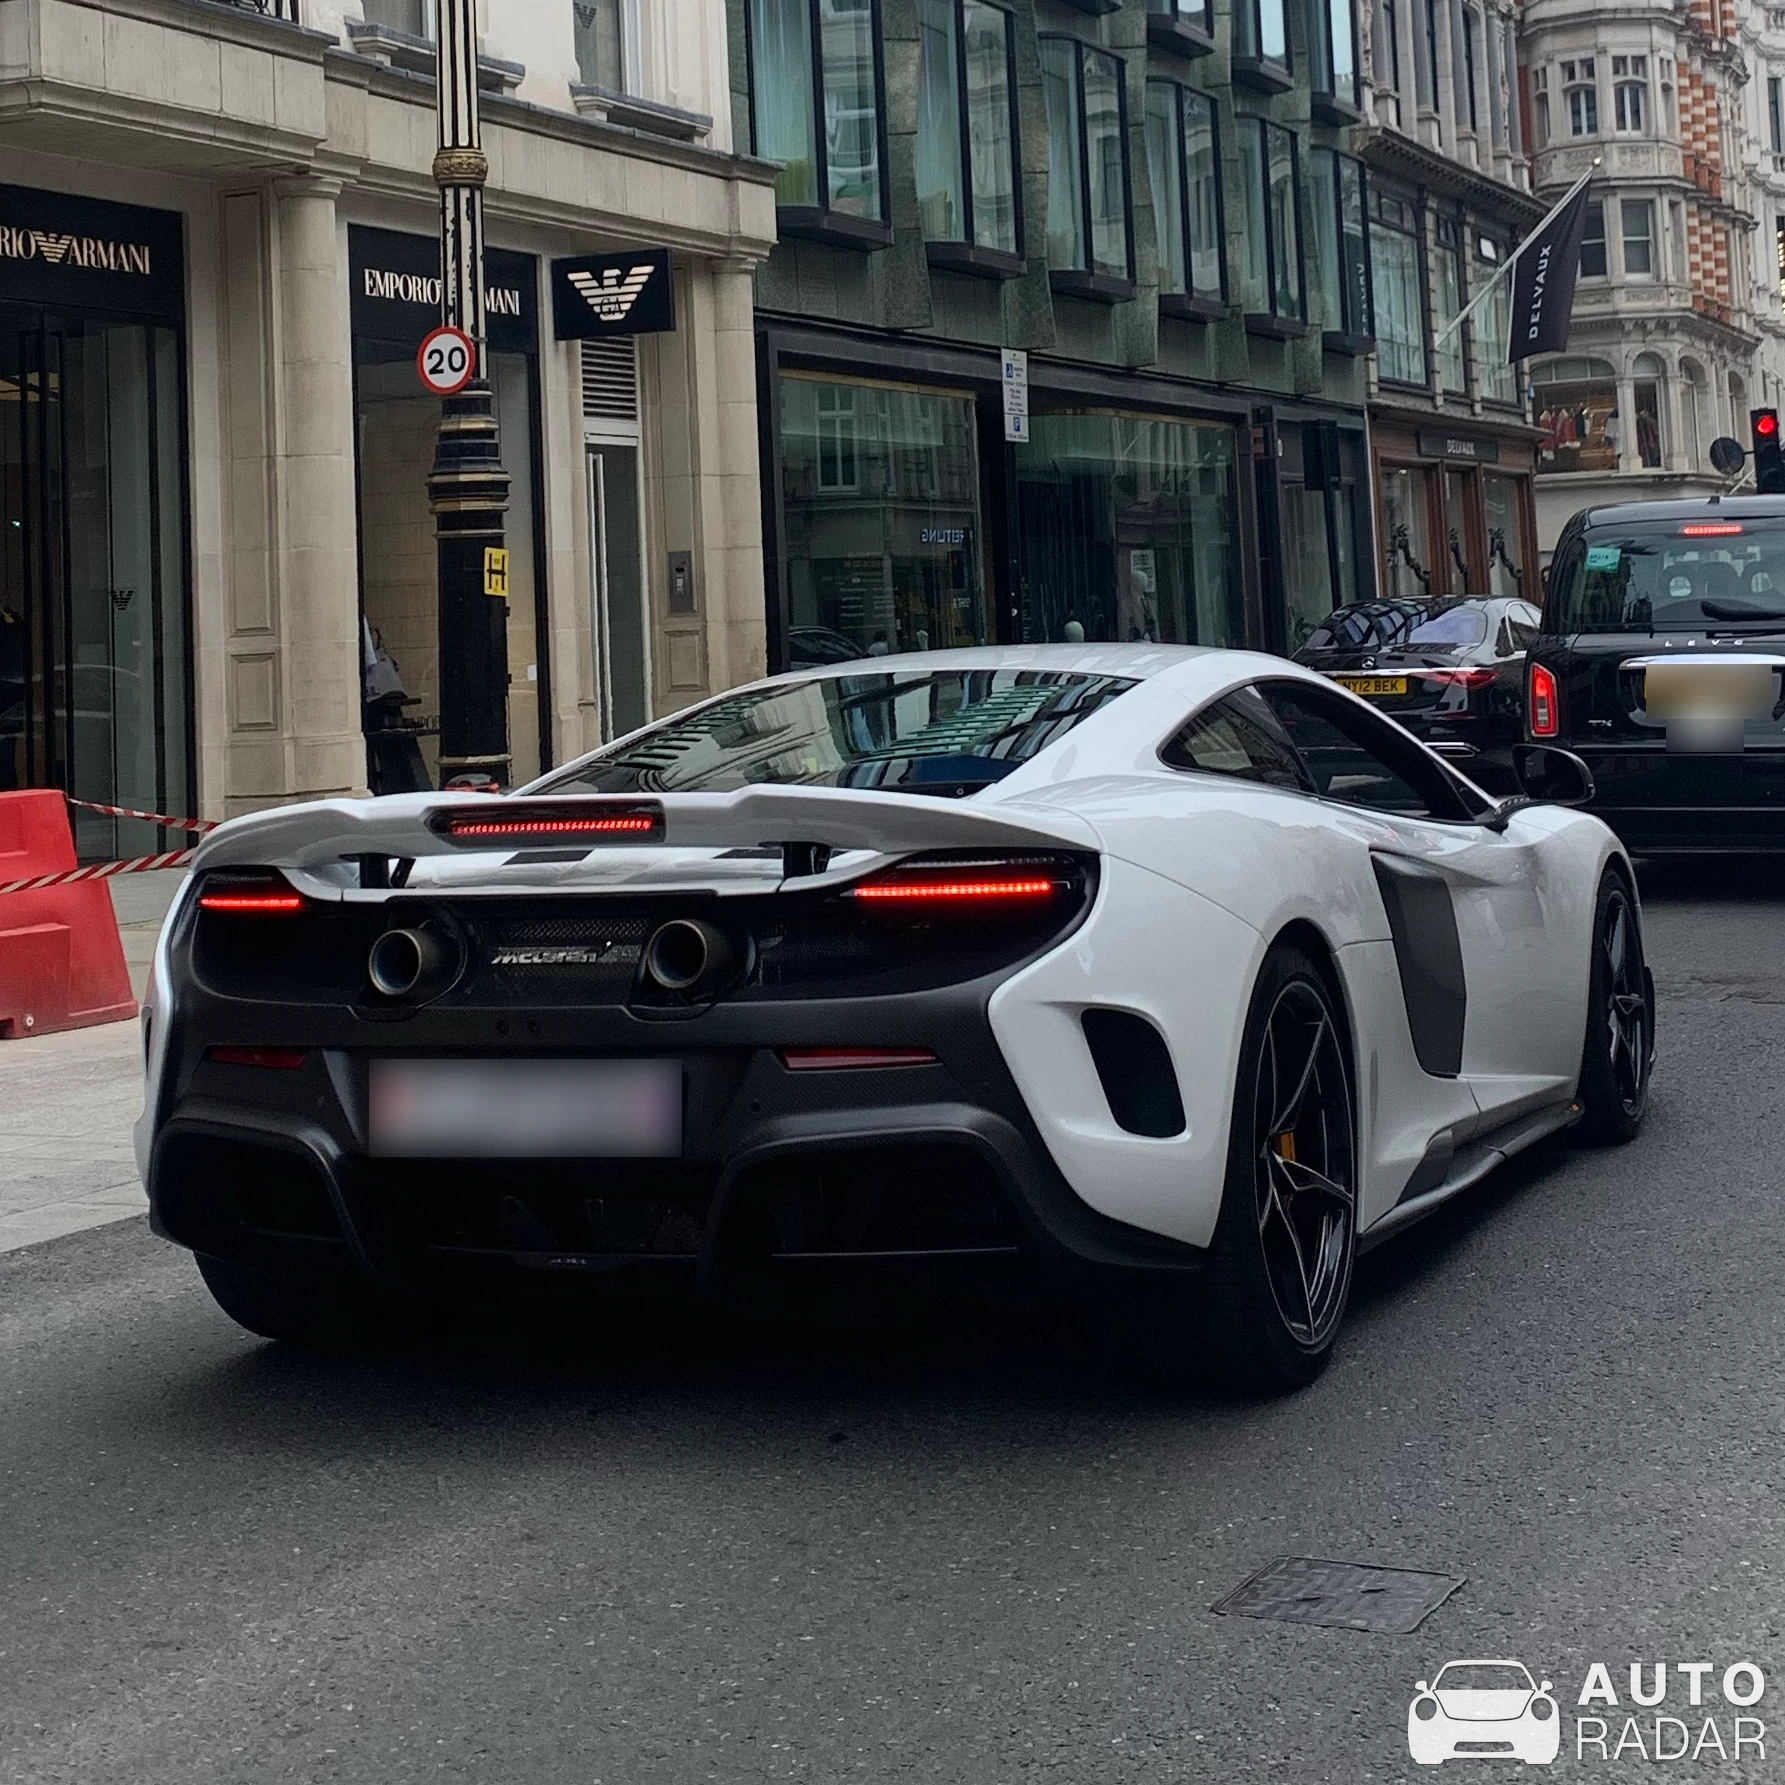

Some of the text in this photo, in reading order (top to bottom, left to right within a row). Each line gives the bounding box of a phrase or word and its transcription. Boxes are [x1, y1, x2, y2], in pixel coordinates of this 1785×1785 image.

[66, 237, 151, 275] ARMANI
[364, 268, 520, 316] EMPORIO MANI
[1529, 244, 1552, 340] DELVAUX
[427, 346, 467, 375] 20
[1373, 681, 1399, 692] BEK
